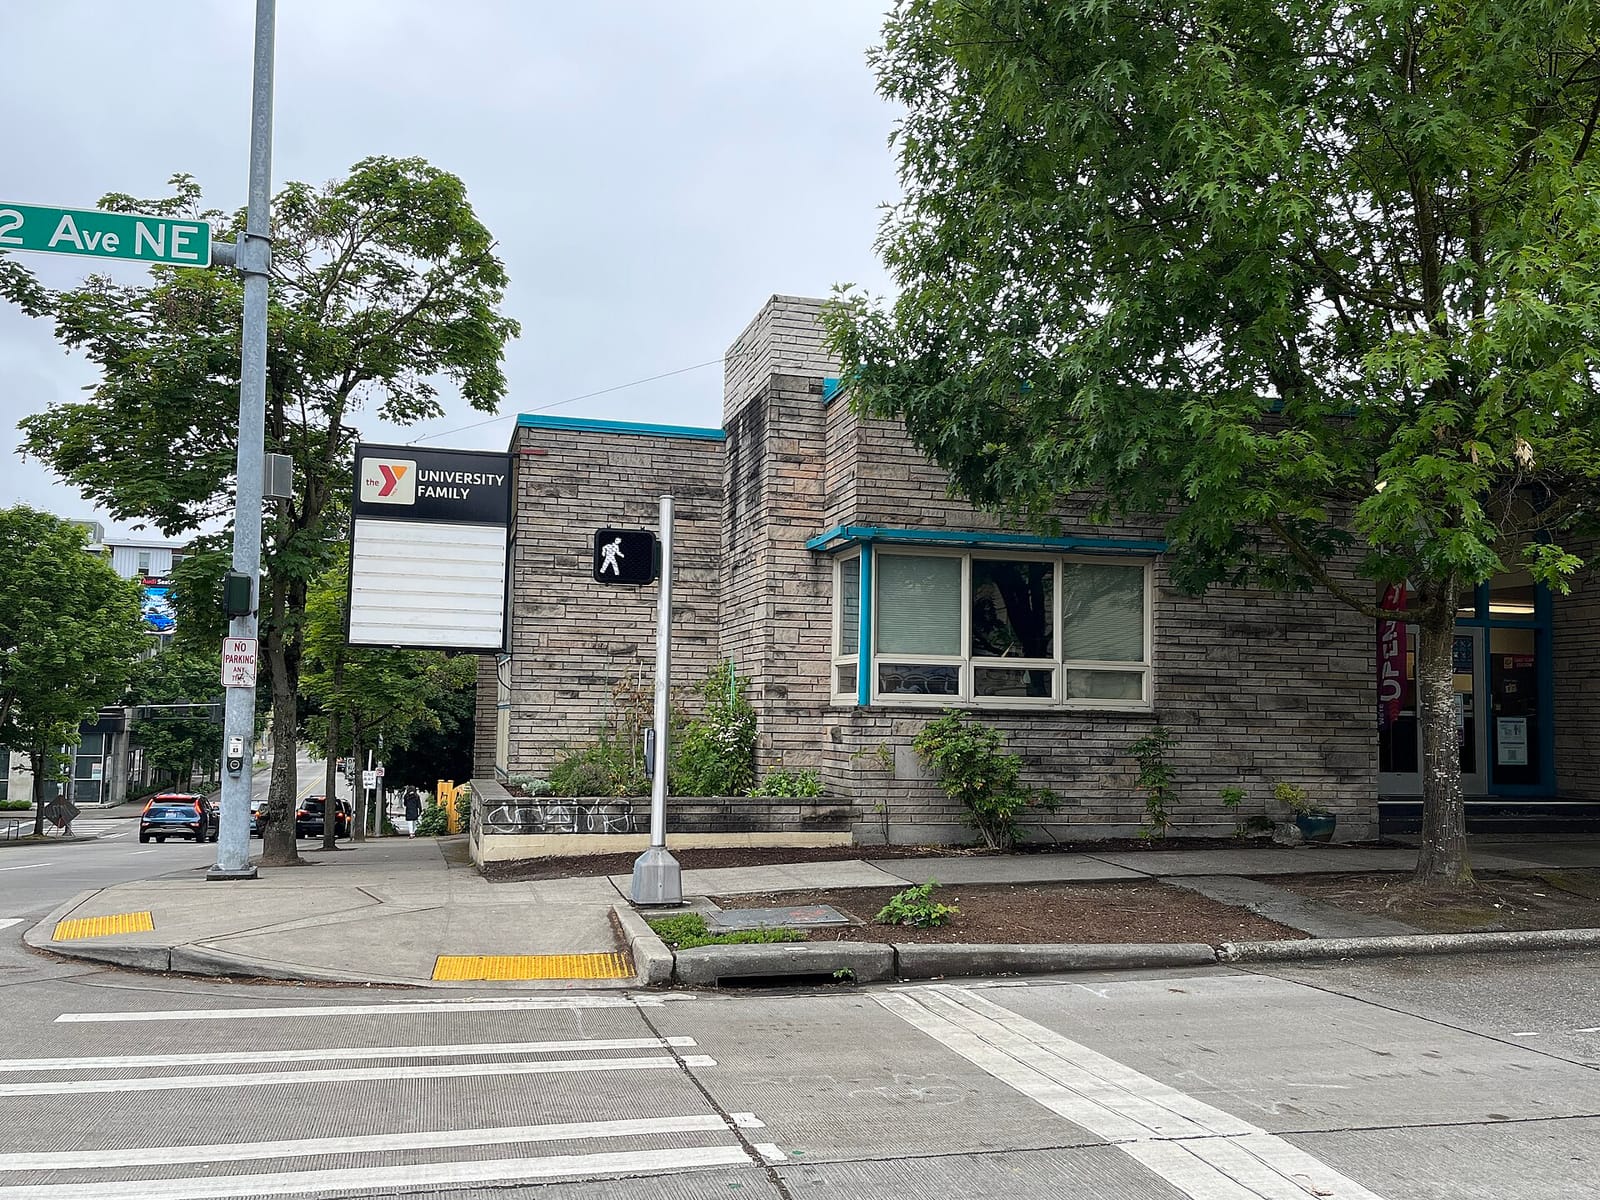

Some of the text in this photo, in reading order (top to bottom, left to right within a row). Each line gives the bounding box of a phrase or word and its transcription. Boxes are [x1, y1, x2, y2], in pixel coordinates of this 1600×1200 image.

[48, 214, 120, 253] Ave
[134, 221, 199, 260] NE
[418, 469, 505, 487] UNIVERSITY
[417, 485, 470, 500] FAMILY
[234, 643, 246, 652] NO
[225, 655, 254, 664] PARKING
